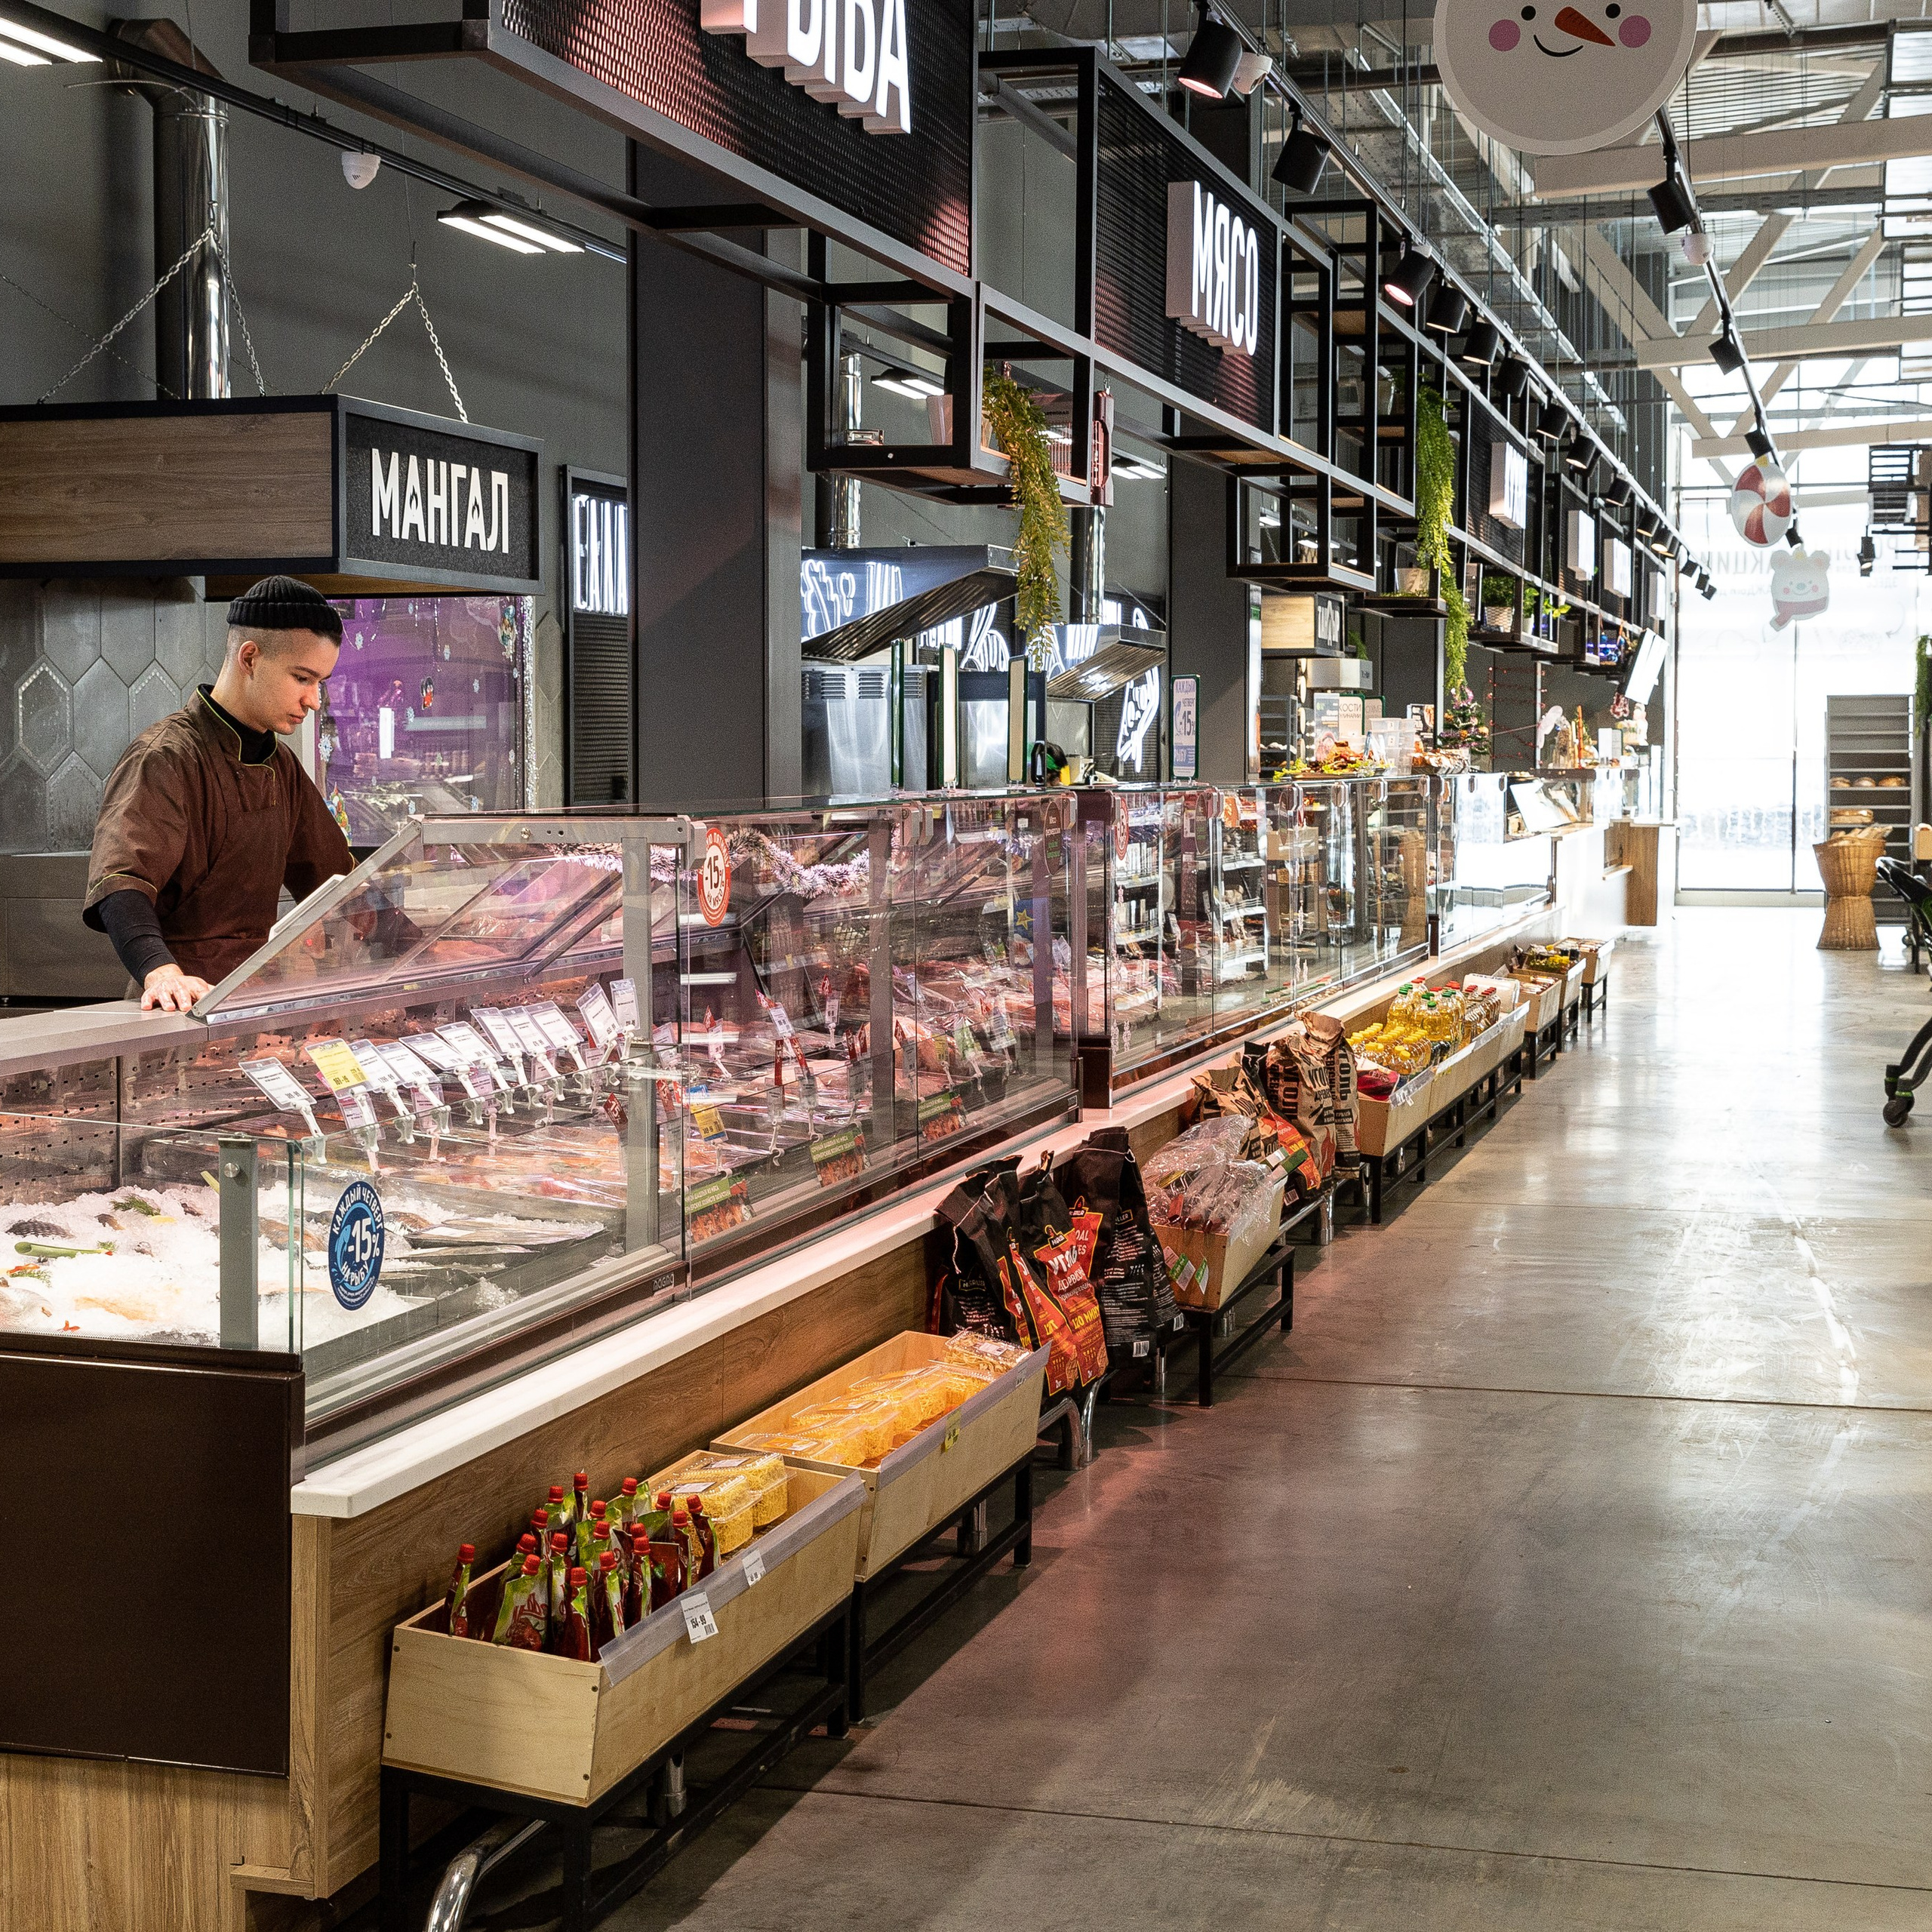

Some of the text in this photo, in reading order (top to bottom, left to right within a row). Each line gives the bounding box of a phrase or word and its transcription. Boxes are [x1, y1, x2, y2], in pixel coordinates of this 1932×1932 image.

[743, 0, 911, 134] БА
[1192, 180, 1259, 356] МЯСО
[371, 448, 509, 554] МАНГАЛ
[706, 855, 724, 890] -15%
[332, 1184, 383, 1235] КАЖДЫЙ ЧЕТВЕРГ
[348, 1217, 380, 1263] -15%
[341, 1260, 369, 1286] НА РЫБУ
